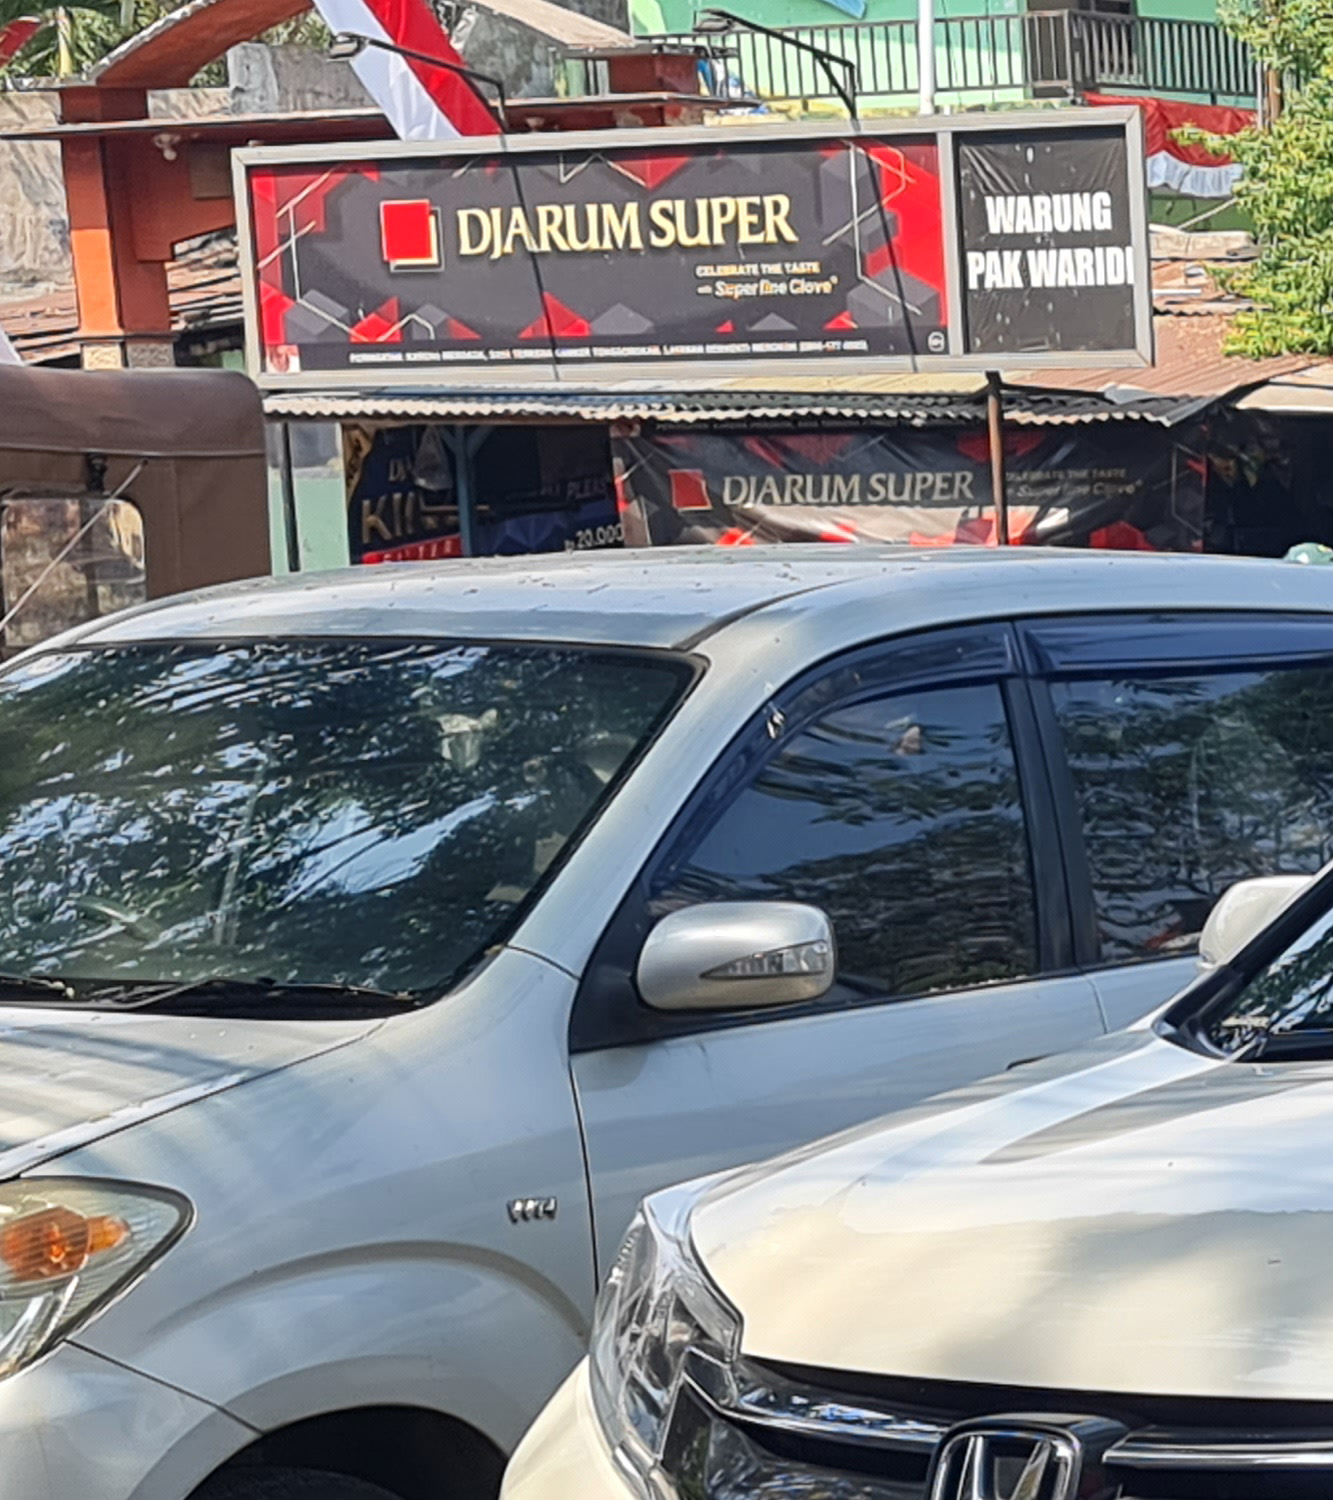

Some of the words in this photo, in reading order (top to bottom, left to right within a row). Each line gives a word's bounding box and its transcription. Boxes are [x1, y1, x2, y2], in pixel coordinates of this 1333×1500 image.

[456, 201, 644, 260] DJARUM
[649, 193, 799, 248] SUPER
[983, 191, 1113, 234] WARUNG
[785, 261, 820, 274] TASTE
[966, 249, 1024, 290] PAK
[1026, 246, 1135, 288] WARIDI
[721, 473, 862, 506] DJARUM
[866, 470, 976, 502] SUPER
[1092, 467, 1127, 479] TASTE
